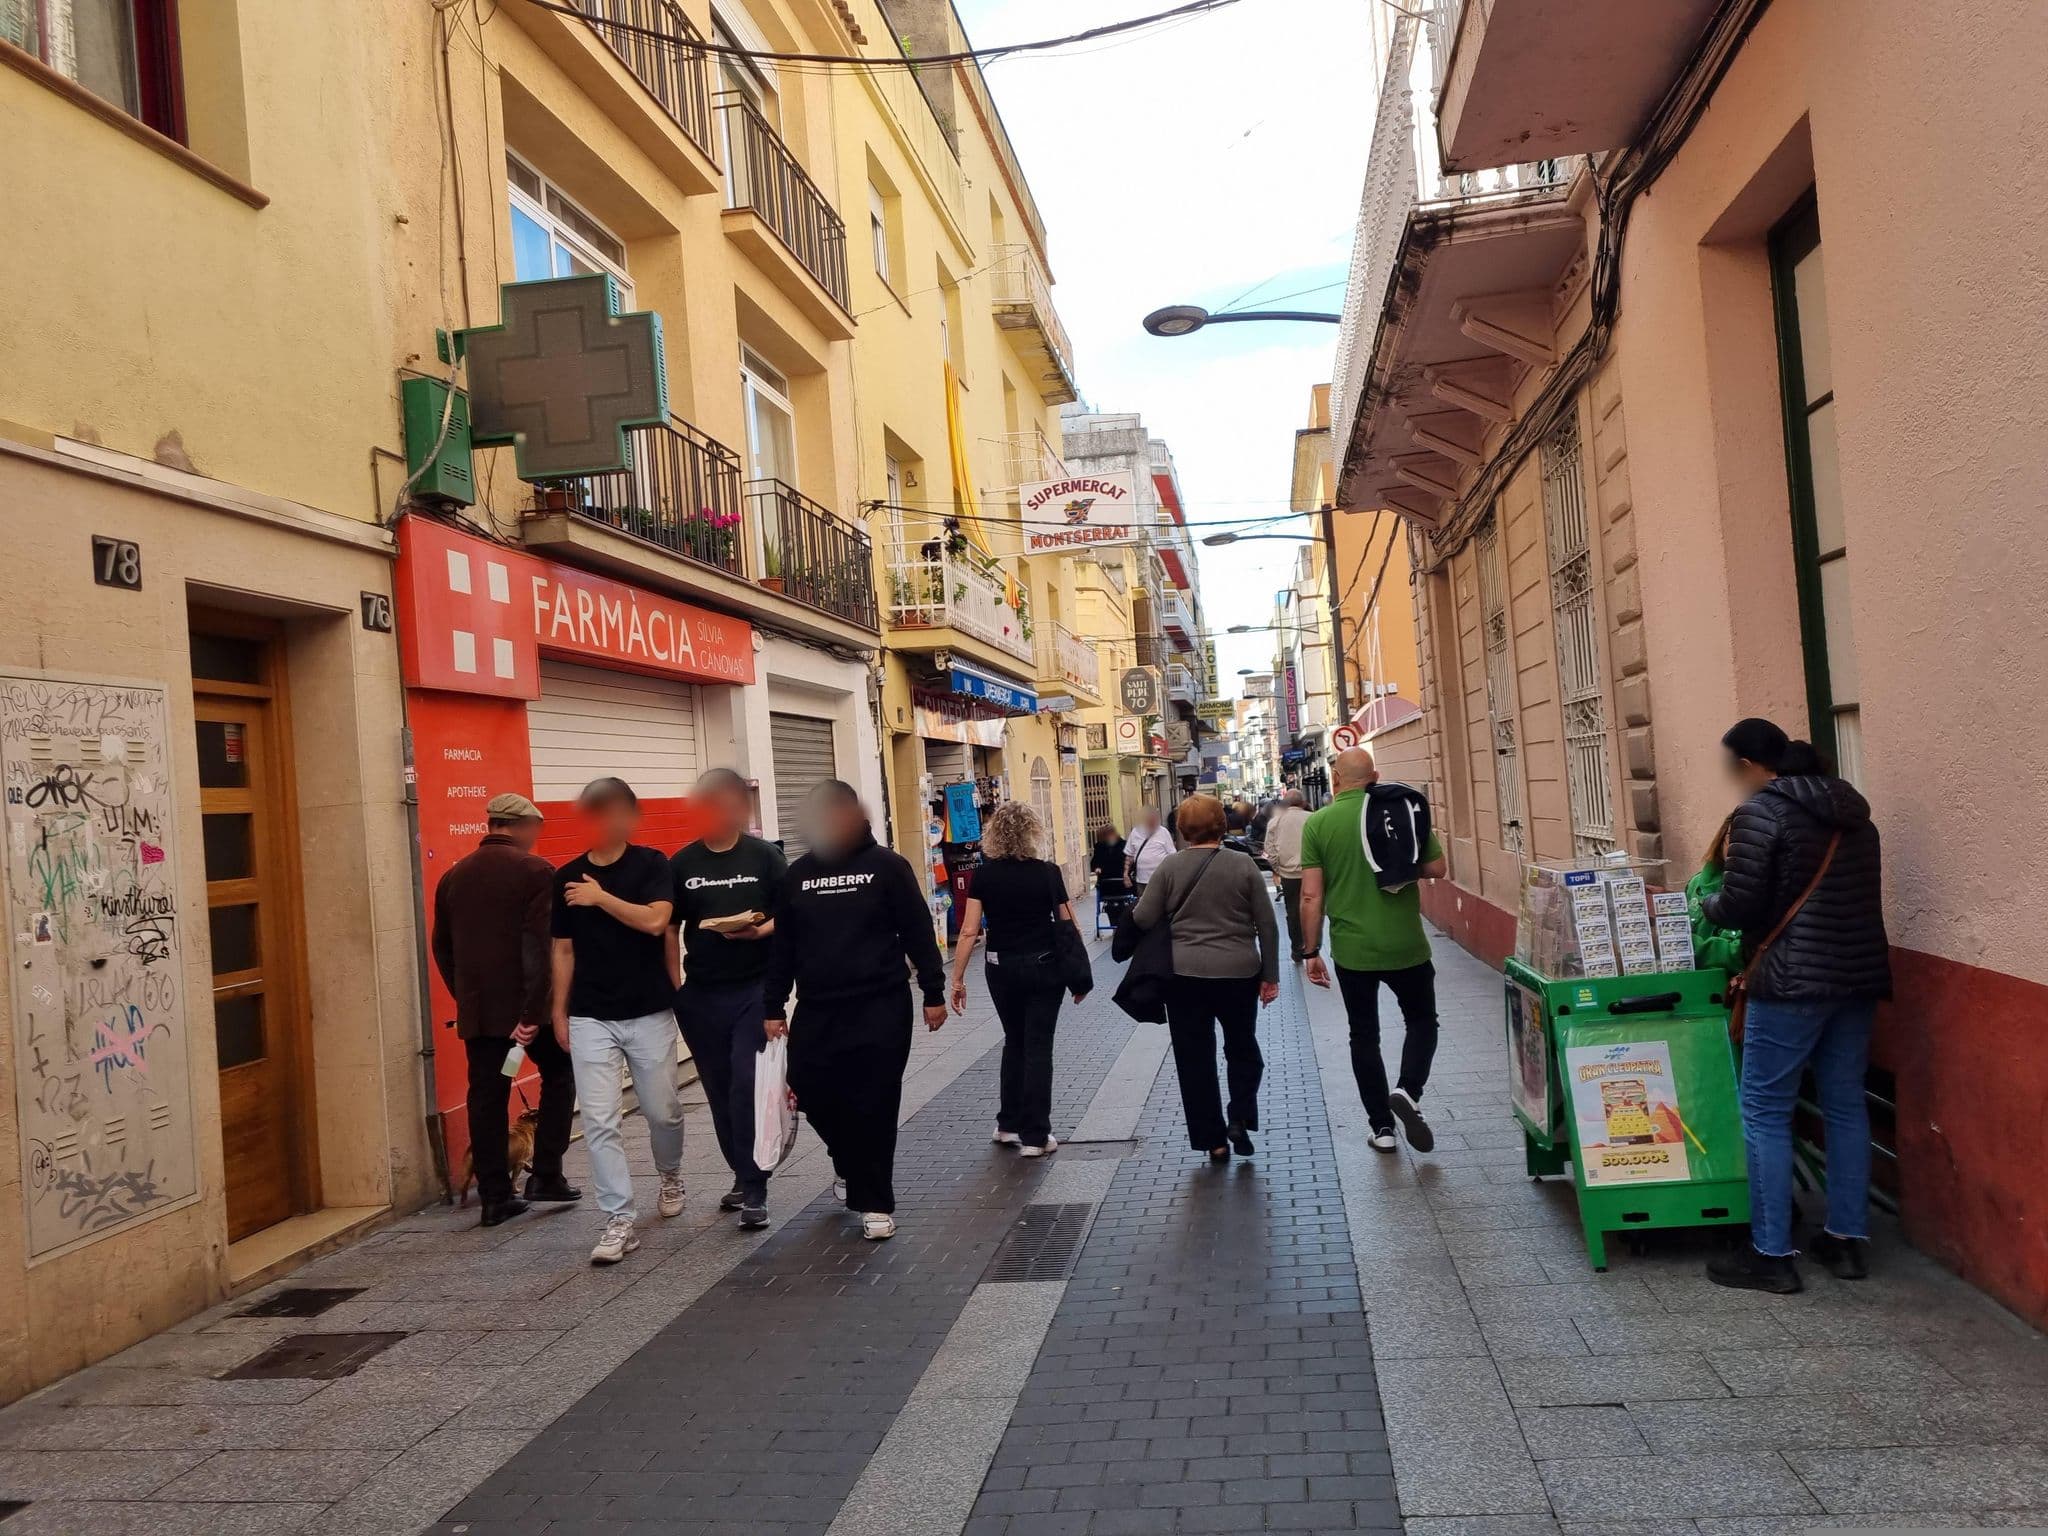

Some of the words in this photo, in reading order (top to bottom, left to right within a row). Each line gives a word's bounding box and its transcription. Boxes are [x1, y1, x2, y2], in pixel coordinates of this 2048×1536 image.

[1027, 480, 1127, 510] SUPERMERCAT
[1030, 526, 1130, 549] MONTSERRAT
[95, 539, 139, 584] 78
[365, 594, 391, 629] 76
[532, 576, 696, 667] FARMÀCIA
[1131, 698, 1147, 709] 70
[447, 786, 487, 798] APOTHEKE
[685, 874, 759, 889] Champion
[802, 873, 874, 891] BURBERRY
